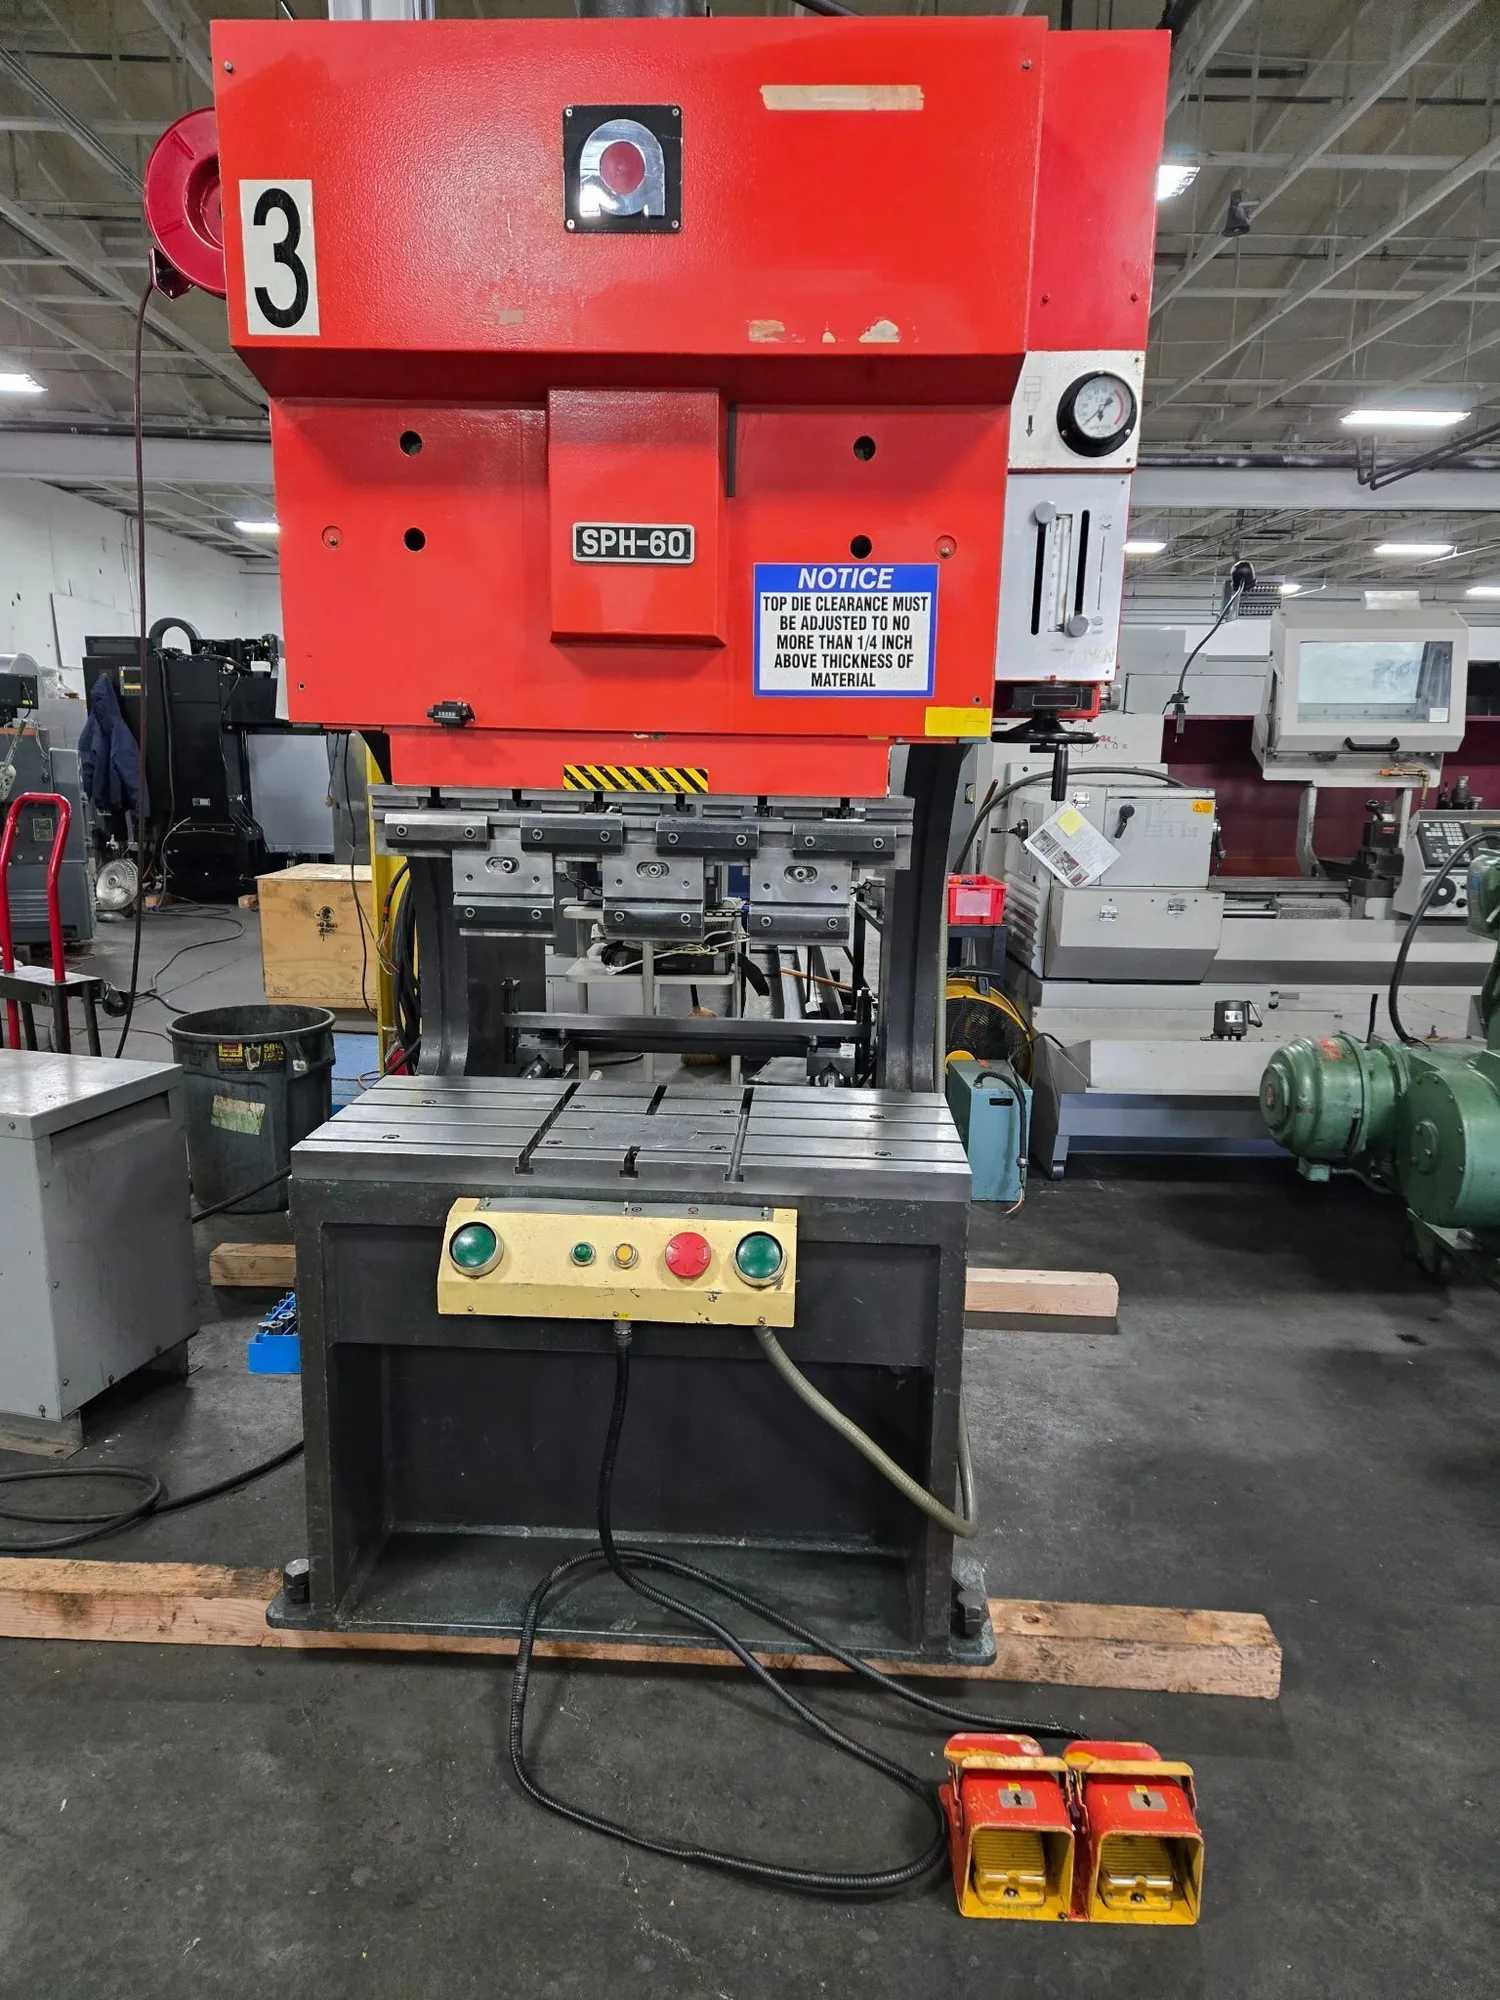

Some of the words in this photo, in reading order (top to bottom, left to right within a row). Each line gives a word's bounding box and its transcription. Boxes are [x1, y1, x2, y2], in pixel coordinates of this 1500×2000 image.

[253, 188, 309, 329] 3
[582, 528, 686, 557] SPH-60
[798, 567, 895, 590] NOTICE
[763, 596, 787, 612] TOP
[791, 596, 812, 612] DIE
[815, 596, 889, 612] CLEARANCE
[892, 596, 929, 612] MUST
[780, 615, 796, 631] BE
[800, 615, 867, 631] ADJUSTED
[872, 615, 888, 631] TO
[892, 615, 910, 631] NO
[776, 634, 814, 650] MORE
[819, 634, 853, 650] THAN
[857, 634, 877, 651] 1/4
[881, 634, 913, 650] INCH
[774, 653, 817, 669] ABOVE
[822, 653, 893, 669] THICKNESS
[897, 653, 914, 669] OF
[811, 672, 876, 687] MATERIAL
